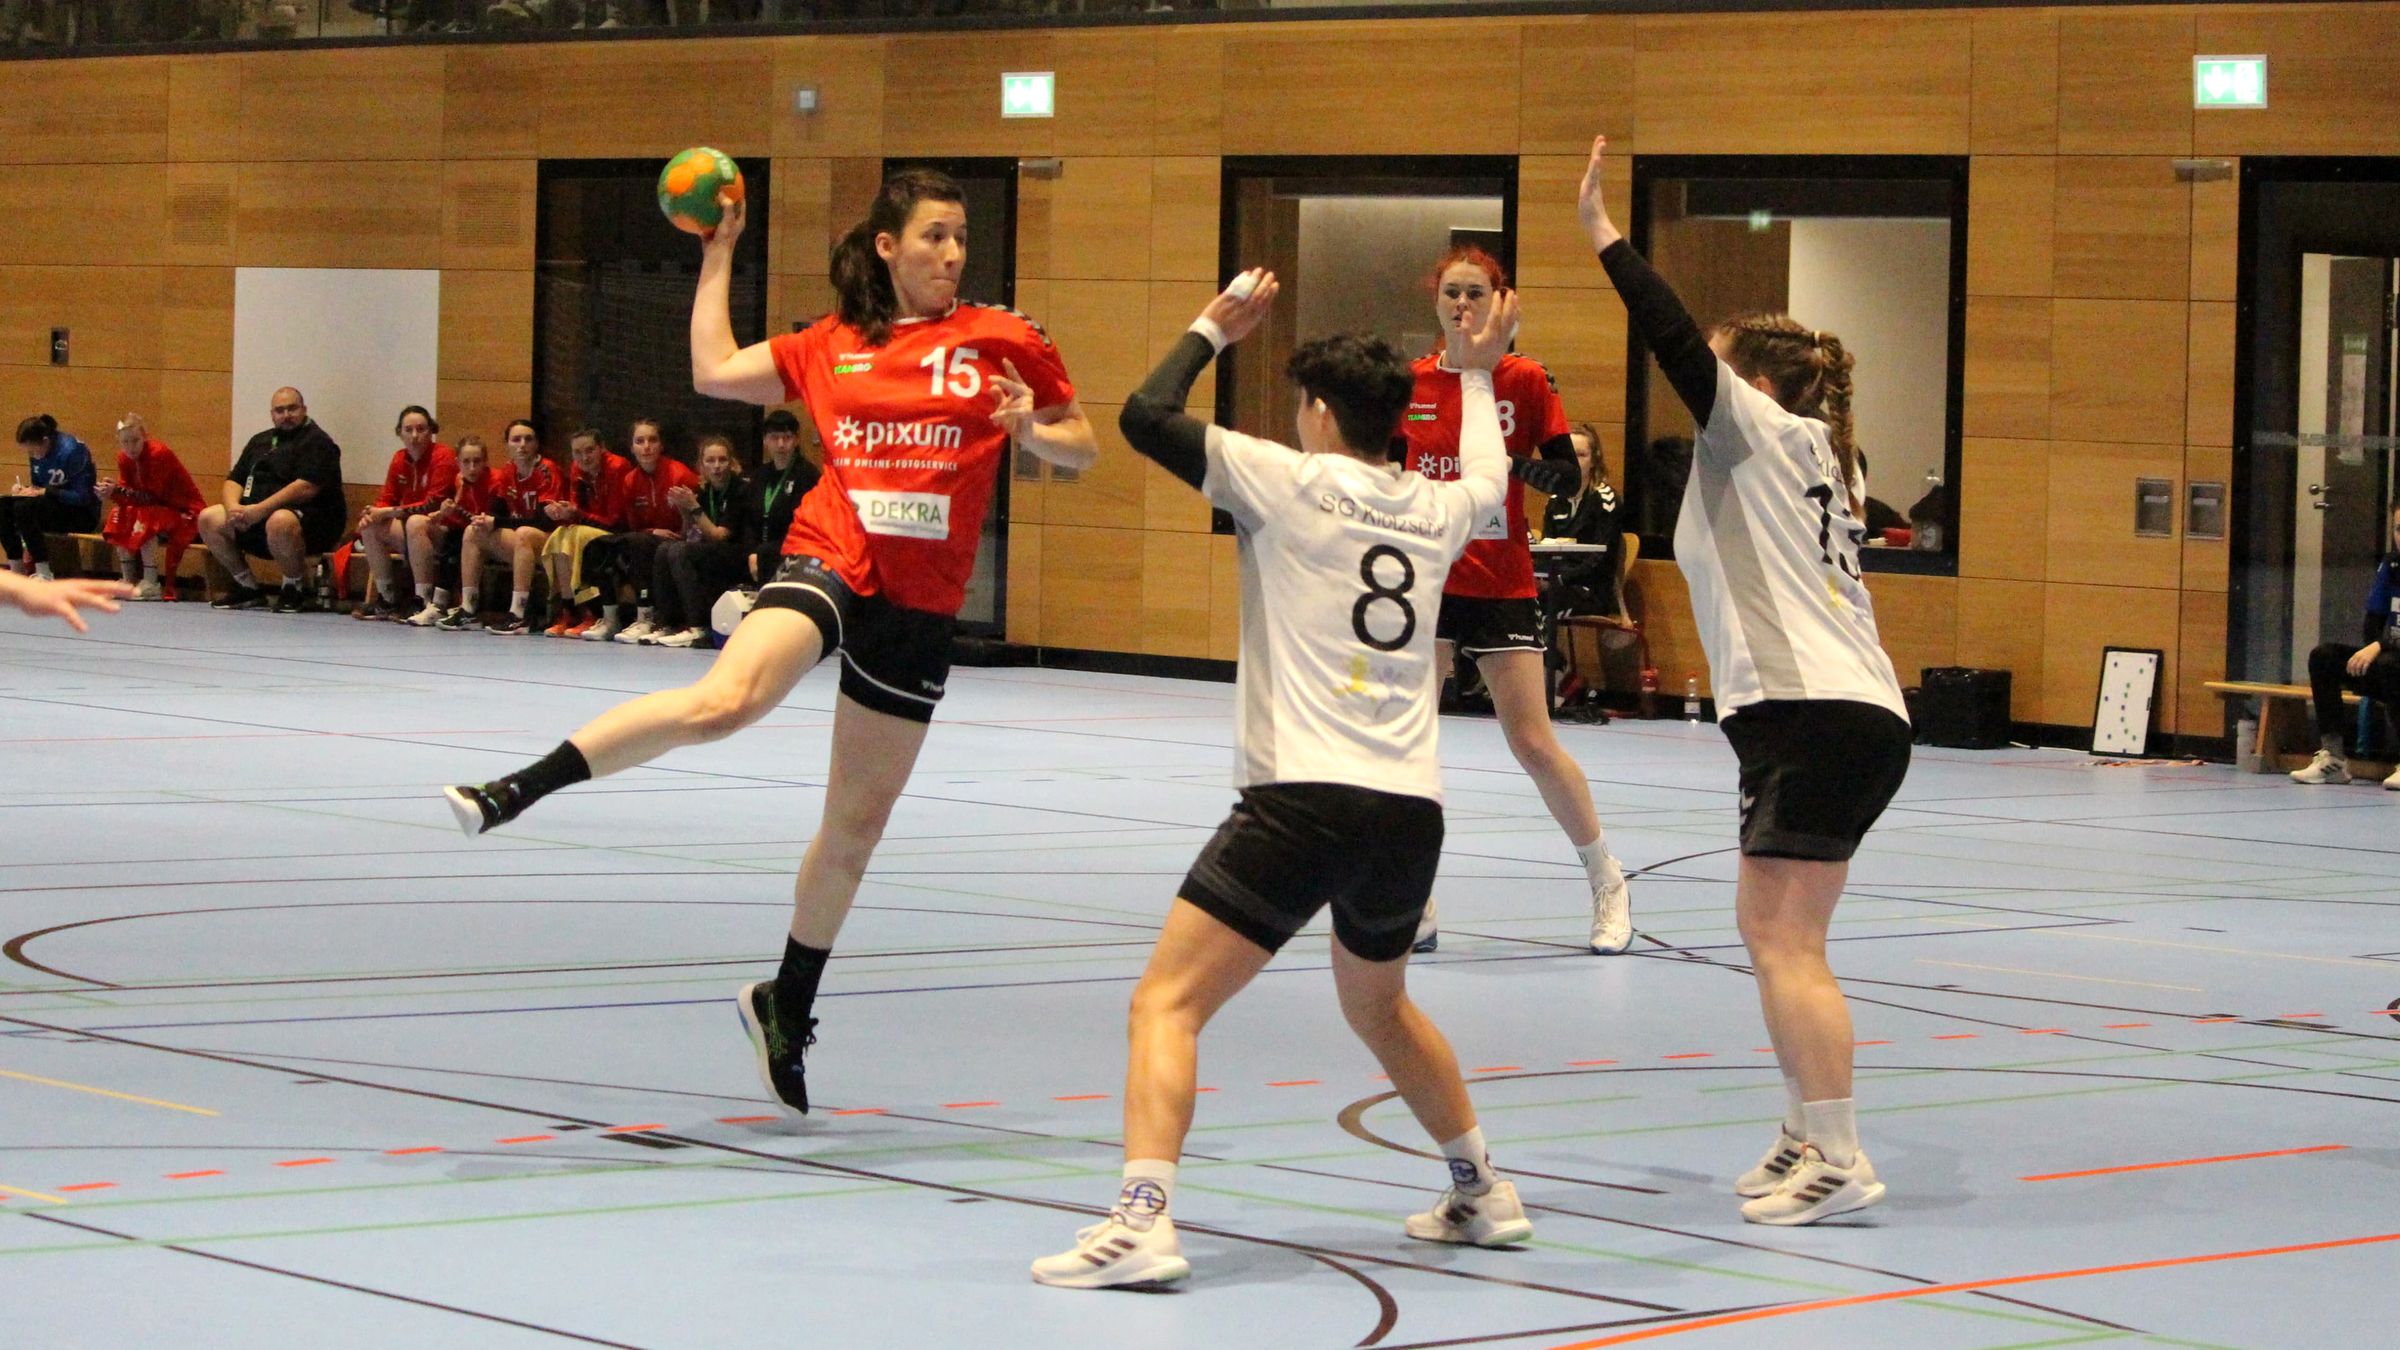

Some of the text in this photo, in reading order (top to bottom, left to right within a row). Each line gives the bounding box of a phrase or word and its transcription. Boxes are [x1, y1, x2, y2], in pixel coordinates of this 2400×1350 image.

[920, 346, 981, 398] 15
[866, 421, 962, 453] pixum
[48, 468, 68, 485] 22
[522, 491, 537, 510] 17
[871, 500, 942, 523] DEKRA
[1320, 493, 1356, 517] SG
[1352, 544, 1416, 652] 8
